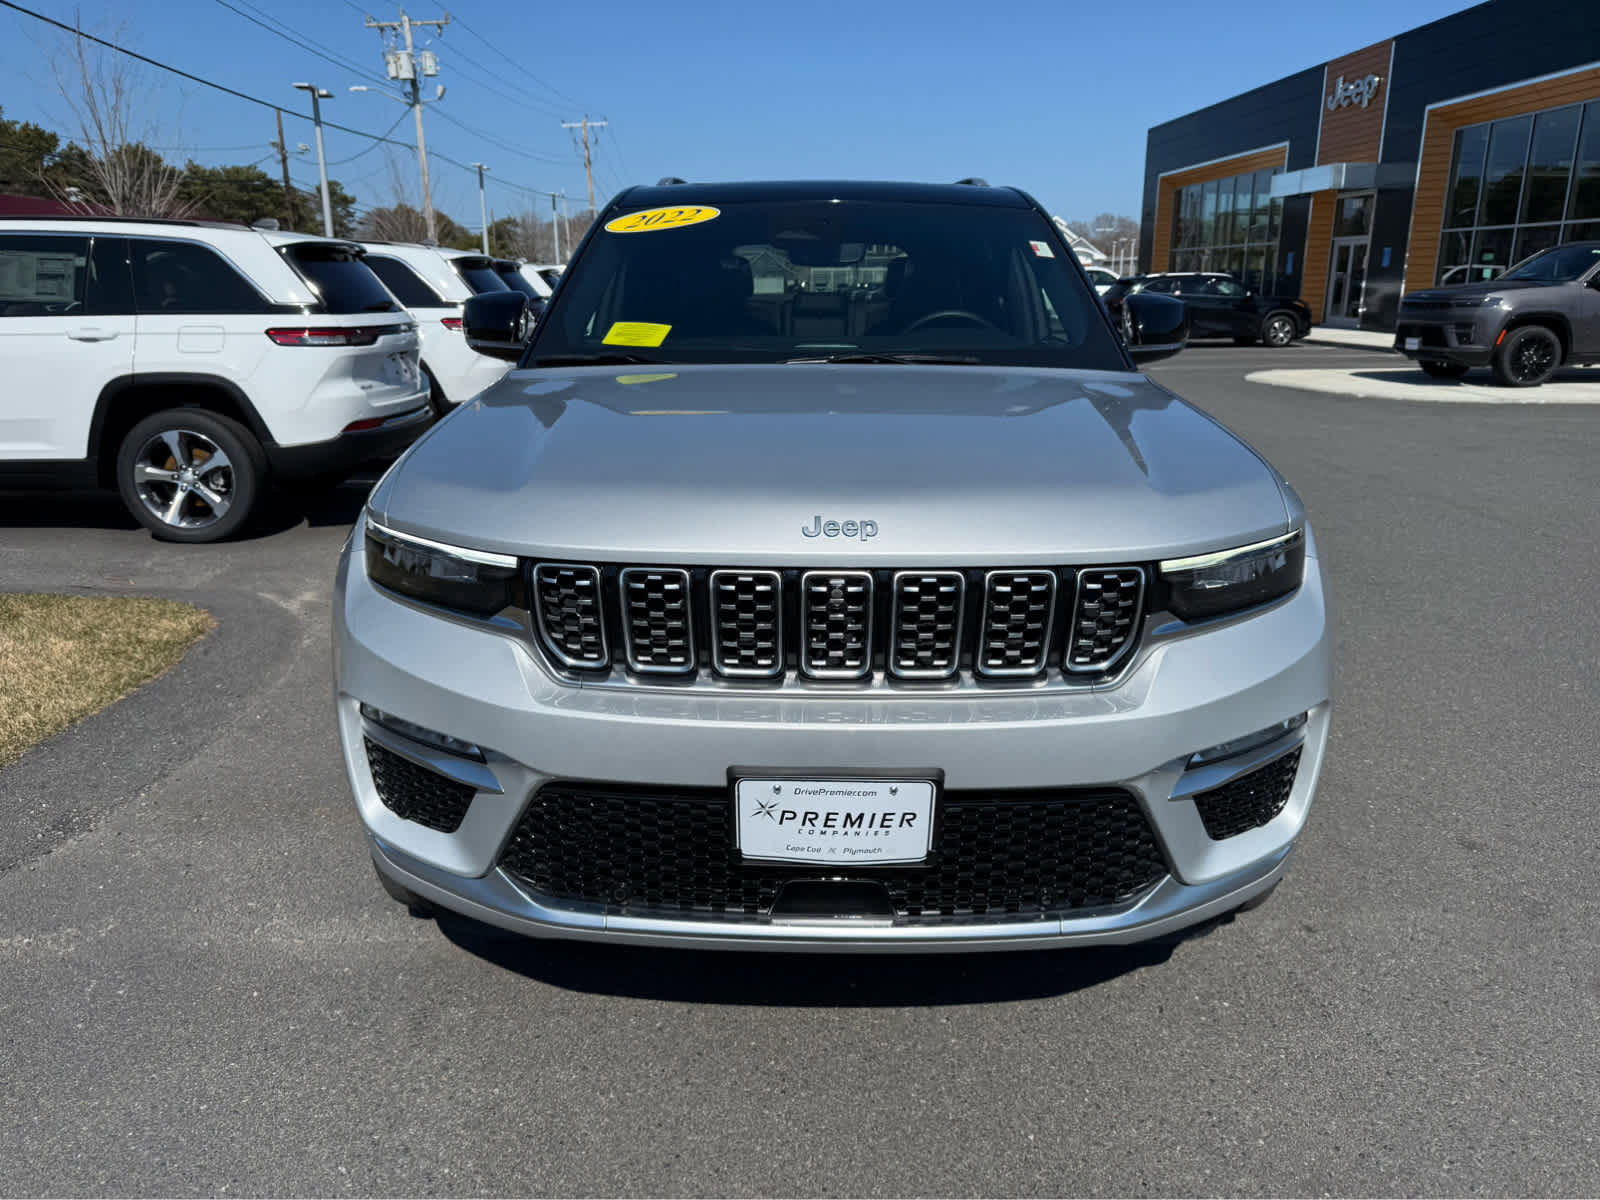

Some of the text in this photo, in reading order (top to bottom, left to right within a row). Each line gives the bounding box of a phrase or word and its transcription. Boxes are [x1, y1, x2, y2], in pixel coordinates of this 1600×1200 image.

[1327, 74, 1379, 111] Jeep
[624, 208, 702, 229] 2022
[801, 515, 878, 541] Jeep
[794, 787, 877, 797] DrivePremier.com
[779, 810, 918, 829] PREMIER
[798, 828, 890, 836] COMPANIES
[786, 844, 805, 853] Cape
[807, 845, 822, 853] Cod
